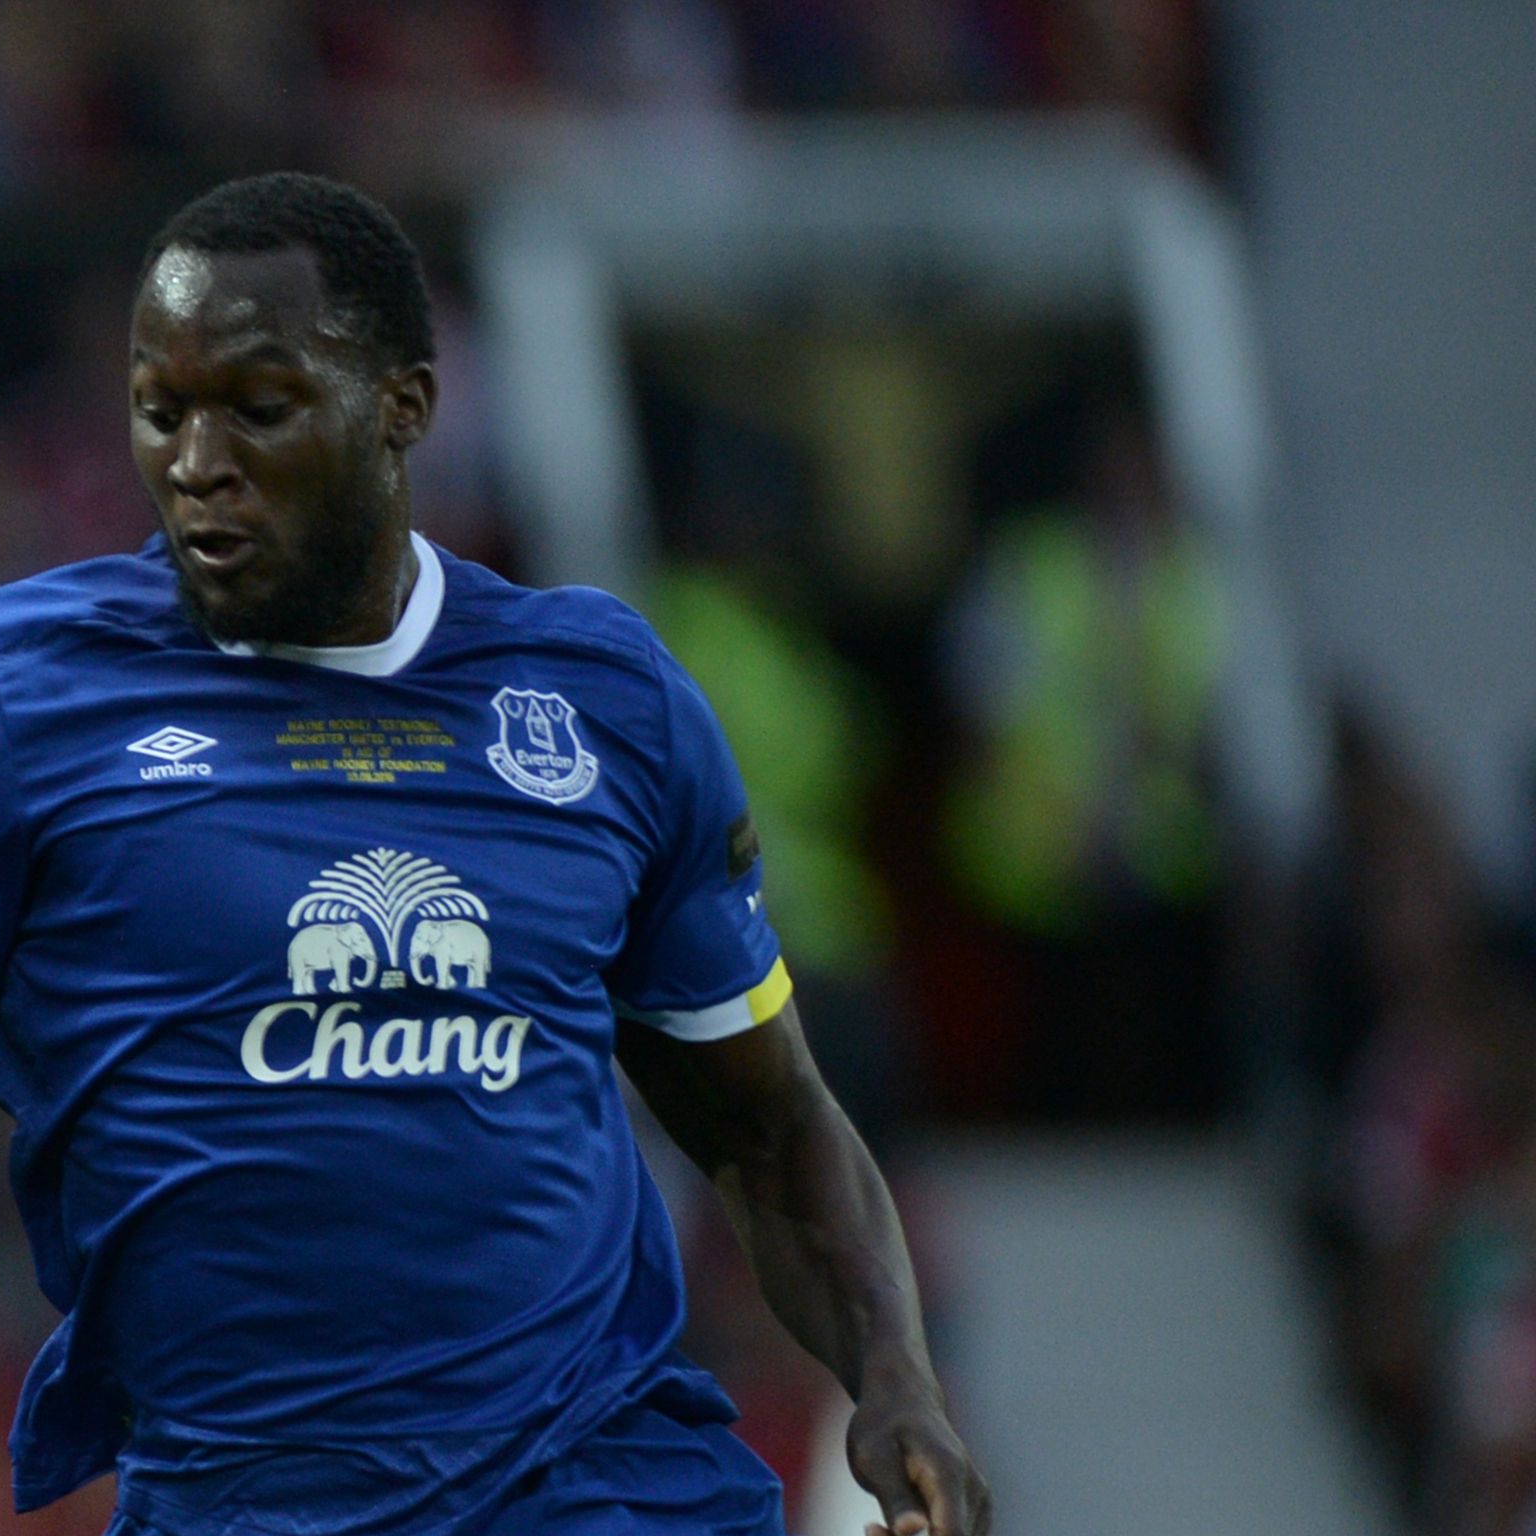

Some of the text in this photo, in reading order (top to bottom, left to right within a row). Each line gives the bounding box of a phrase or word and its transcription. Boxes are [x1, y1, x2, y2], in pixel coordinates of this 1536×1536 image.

[379, 760, 447, 772] FOUNDATION
[514, 749, 573, 770] Everton
[139, 760, 213, 781] umbro
[241, 1001, 532, 1093] Chang
